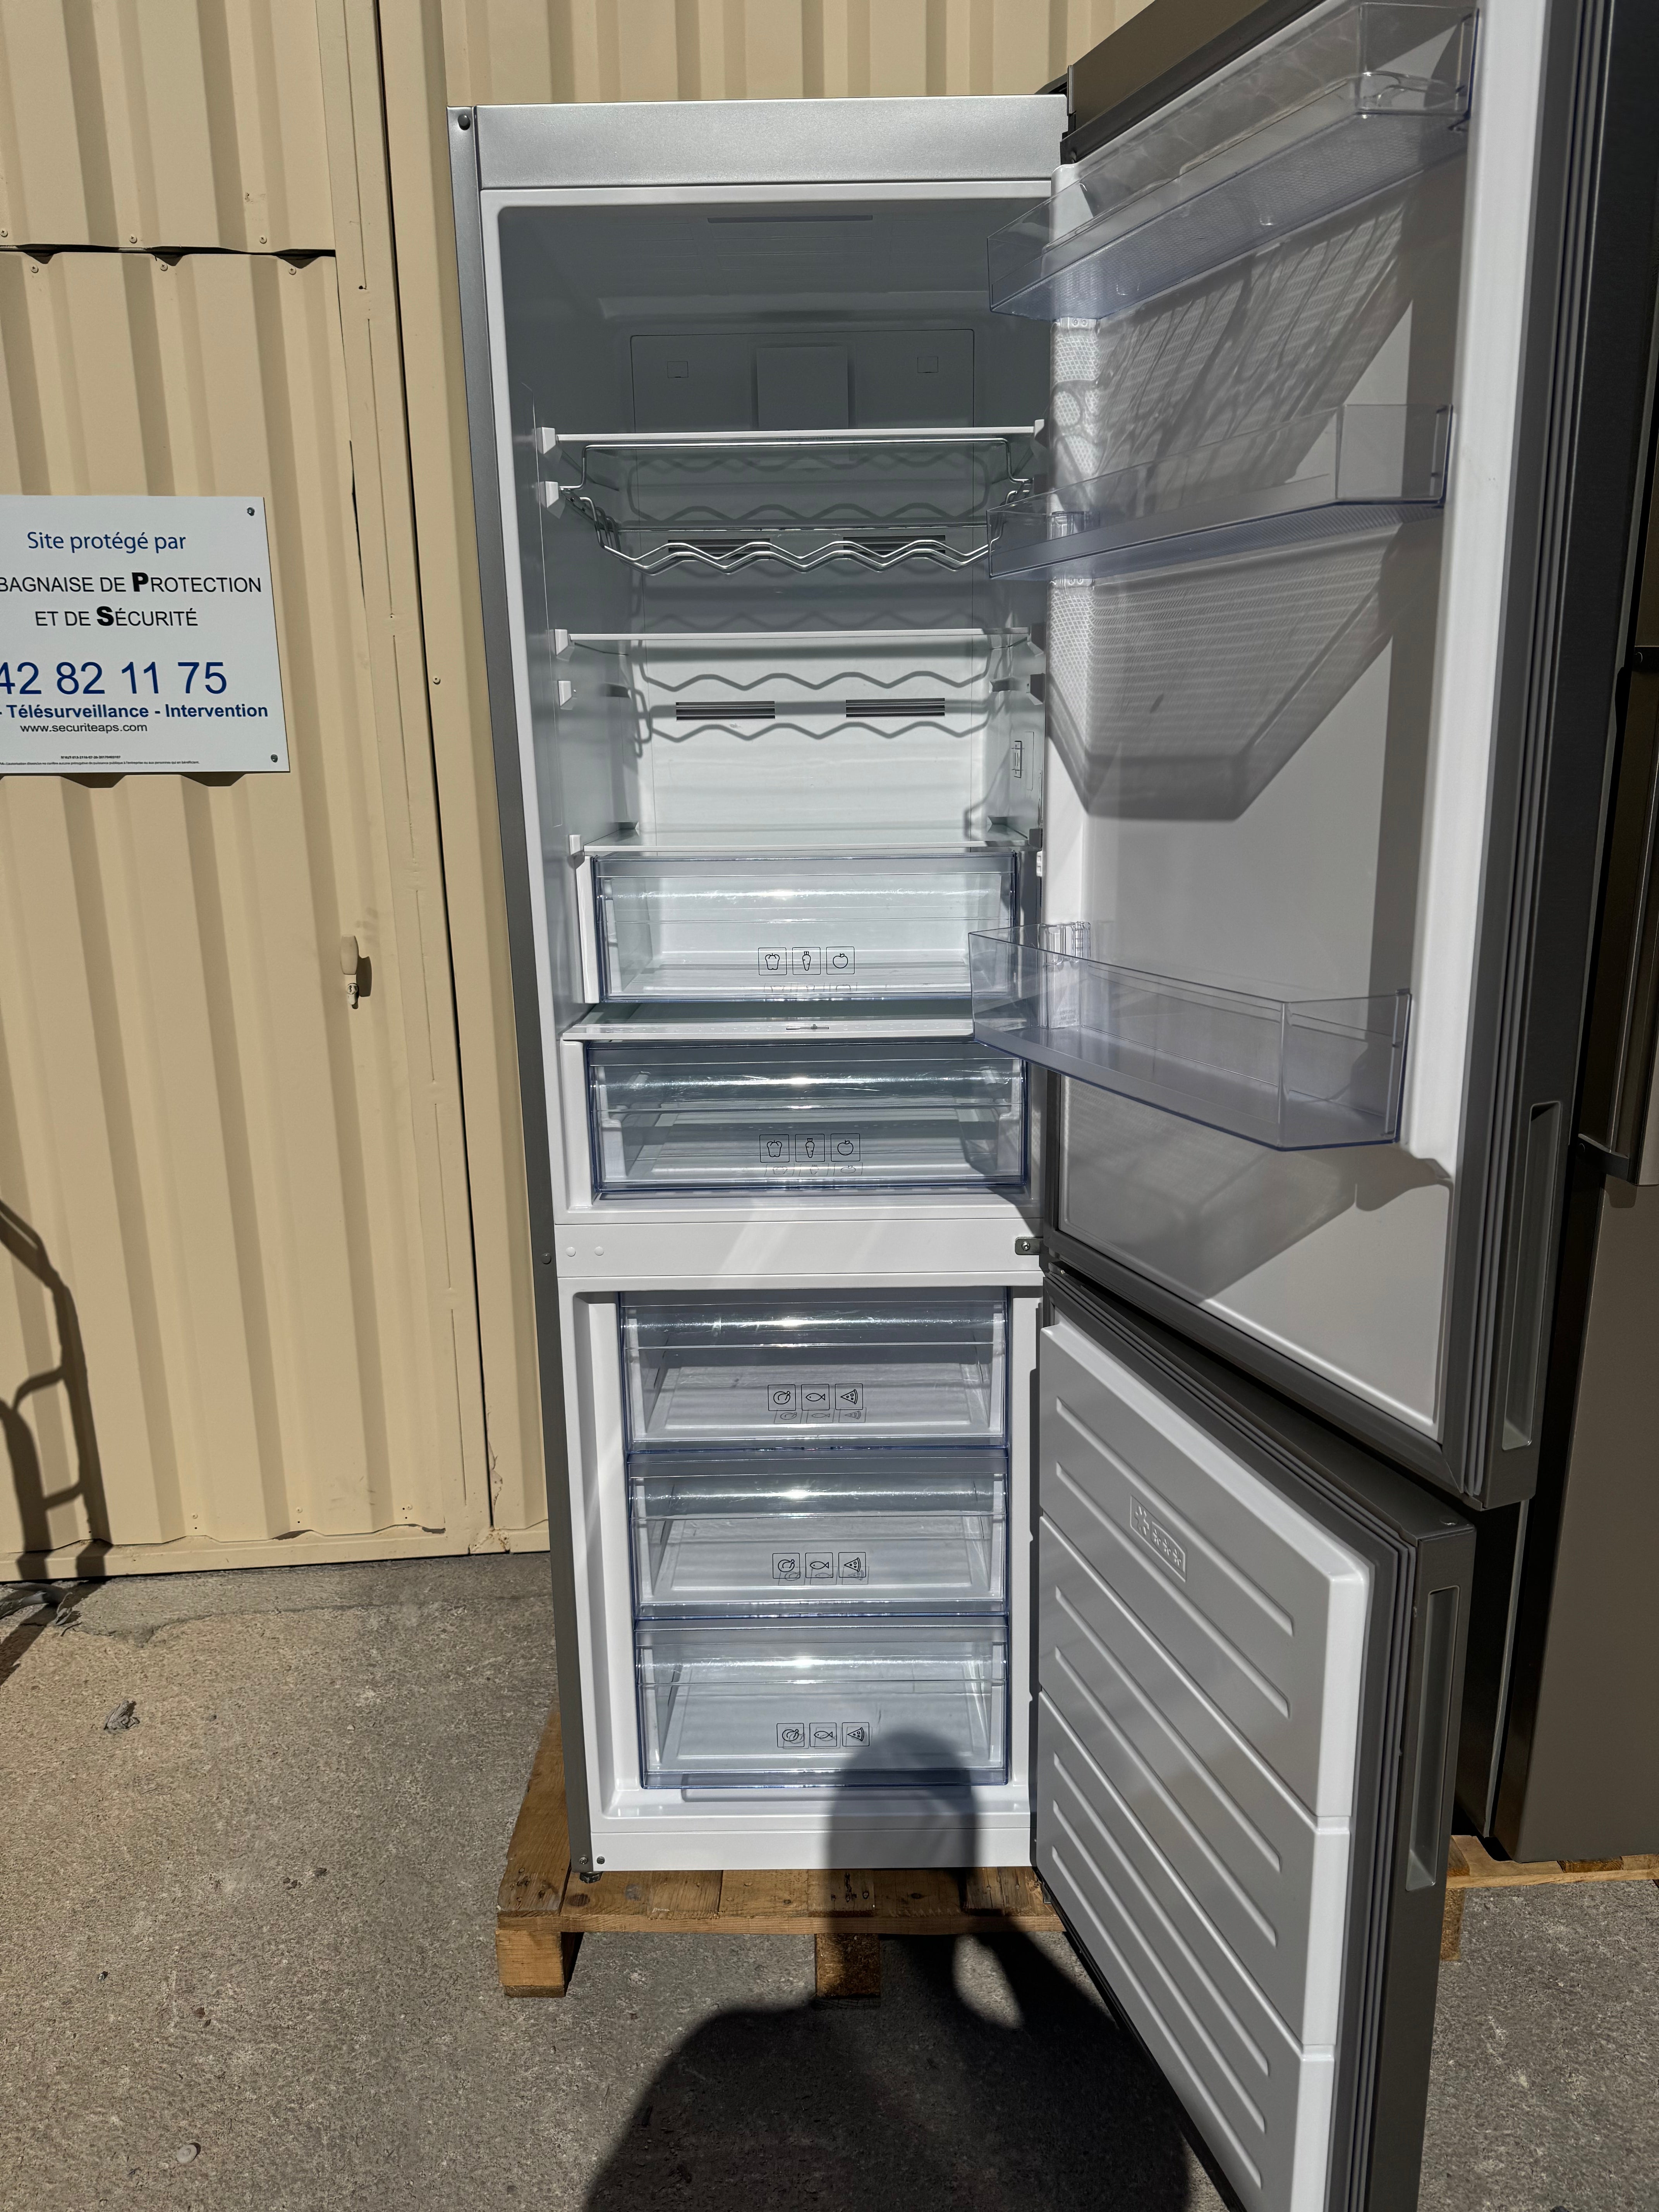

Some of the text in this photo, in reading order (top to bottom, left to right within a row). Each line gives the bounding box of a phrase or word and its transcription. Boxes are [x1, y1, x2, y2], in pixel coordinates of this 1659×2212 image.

[27, 531, 186, 554] Site protégé par
[0, 572, 261, 592] BAGNAISE DE PROTECTION
[35, 606, 198, 627] ET DE SÉCURITÉ
[0, 661, 227, 695] 42 82 11 75
[6, 704, 149, 718] Télésurveillance
[165, 704, 268, 717] Intervention
[20, 723, 148, 734] www.securiteaps.com
